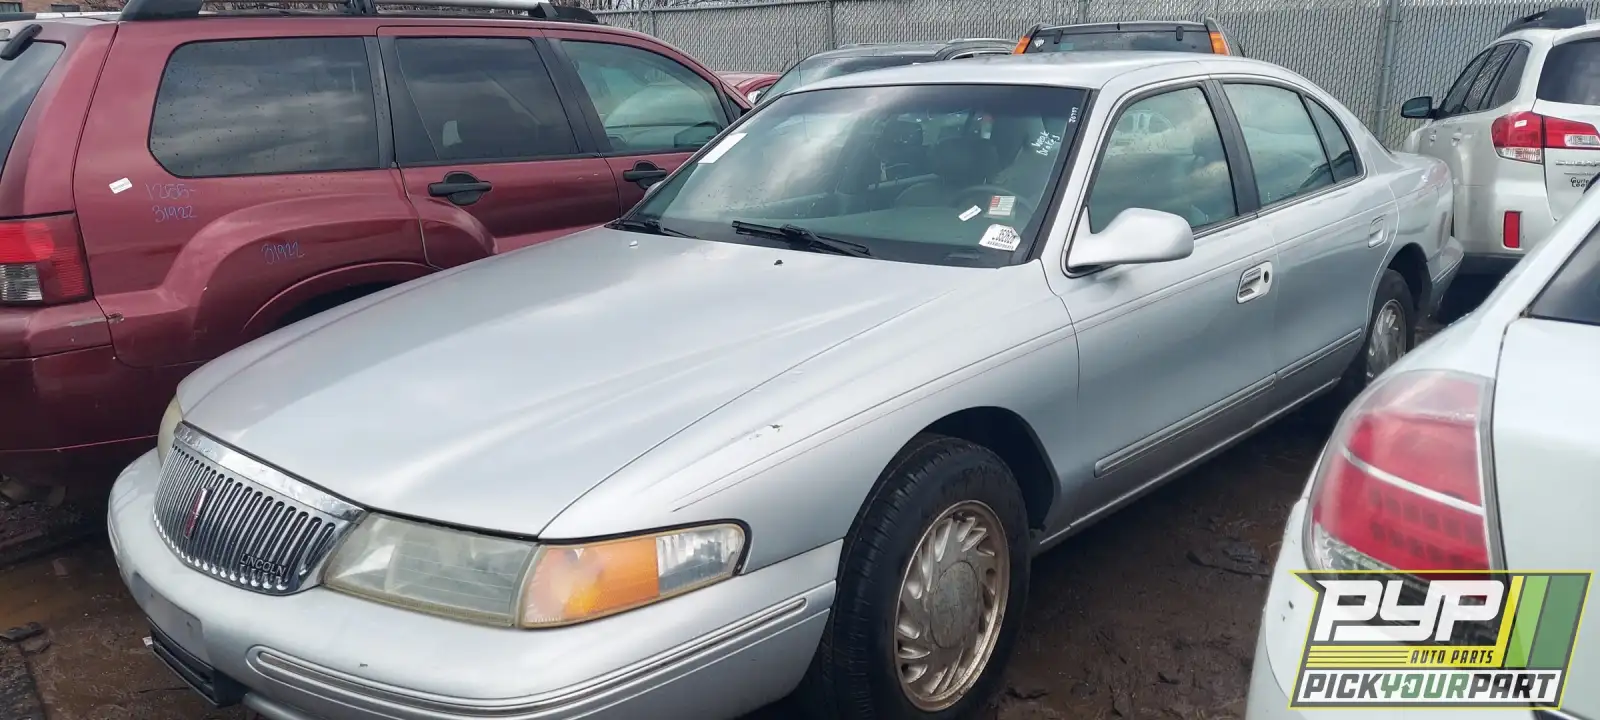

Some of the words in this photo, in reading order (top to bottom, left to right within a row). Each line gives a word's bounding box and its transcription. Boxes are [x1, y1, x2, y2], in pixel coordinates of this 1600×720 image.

[152, 204, 198, 222] 31922
[261, 241, 305, 265] 31922
[240, 553, 287, 577] LINCOLN
